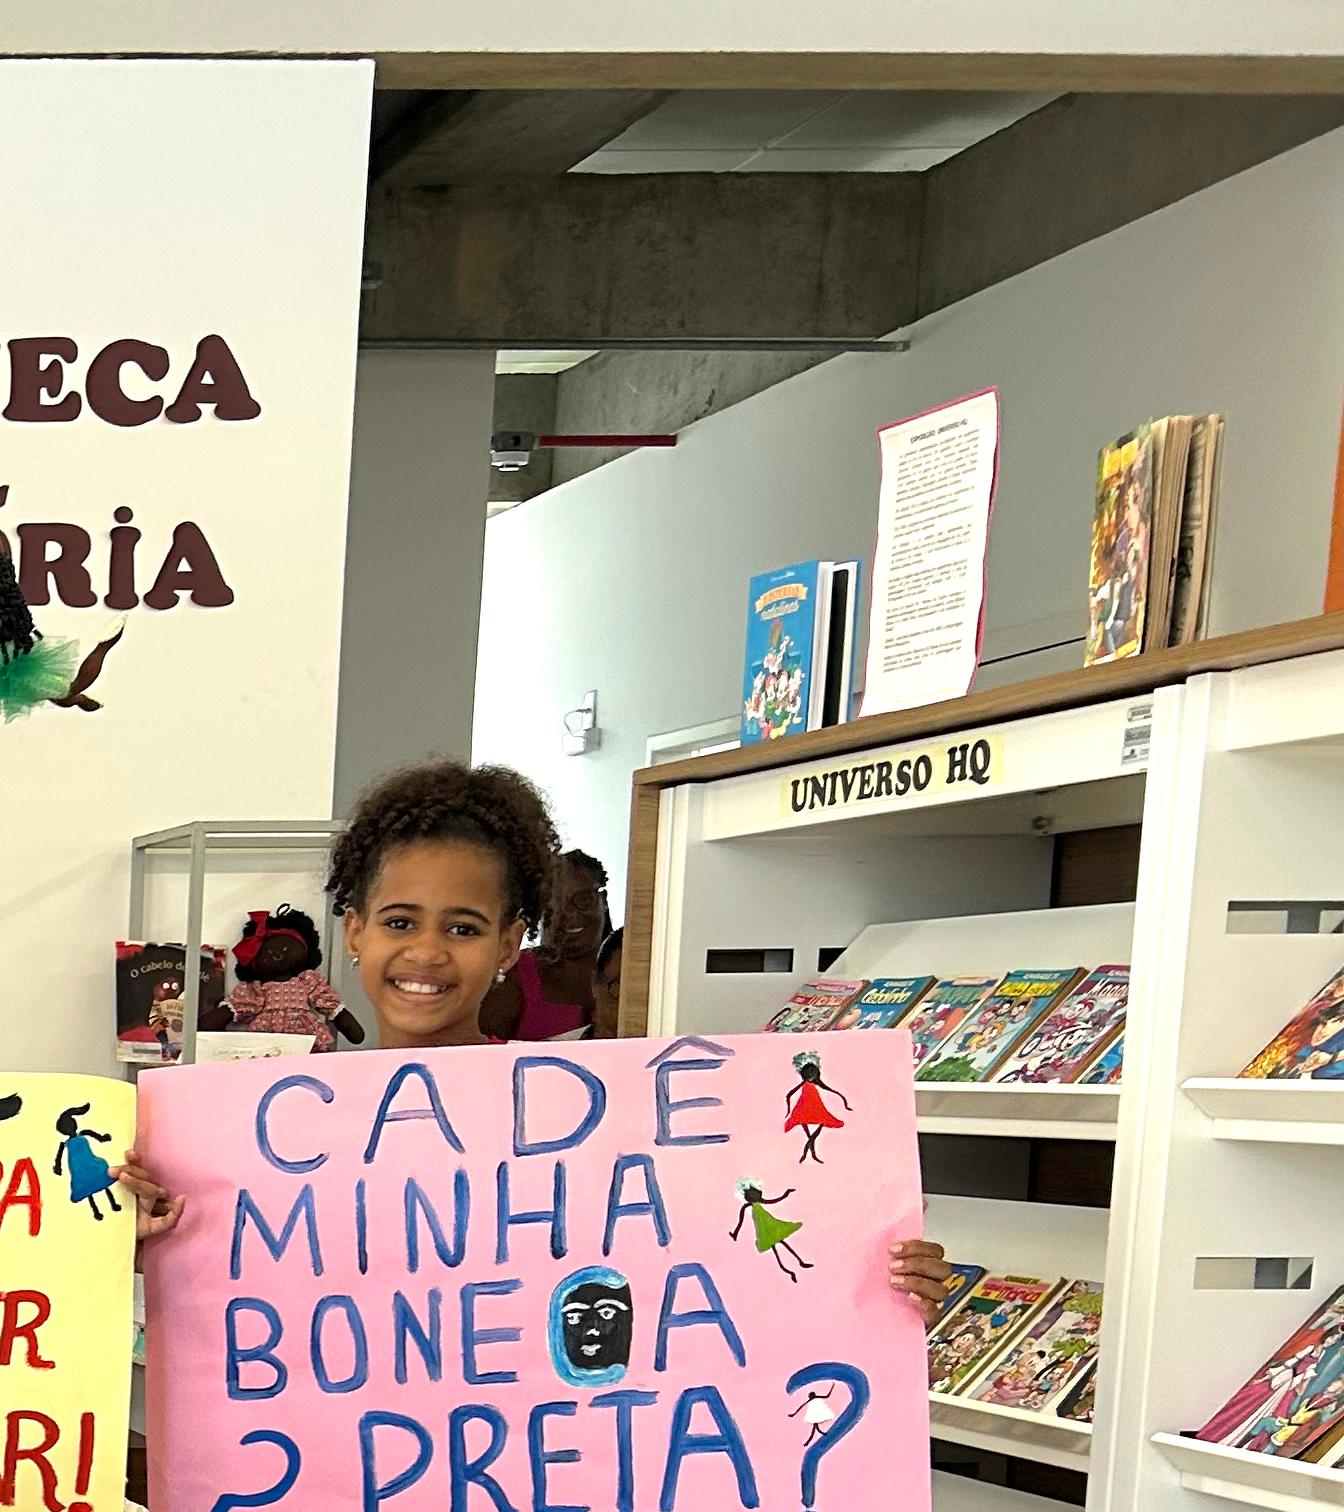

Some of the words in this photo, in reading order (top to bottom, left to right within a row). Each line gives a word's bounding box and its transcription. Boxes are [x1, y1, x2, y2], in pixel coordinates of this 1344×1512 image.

[790, 756, 932, 812] UNIVERSO
[946, 738, 992, 785] HQ
[140, 960, 173, 974] cabelo
[256, 1036, 736, 1173] CADÊ
[229, 1153, 673, 1280] MINHA
